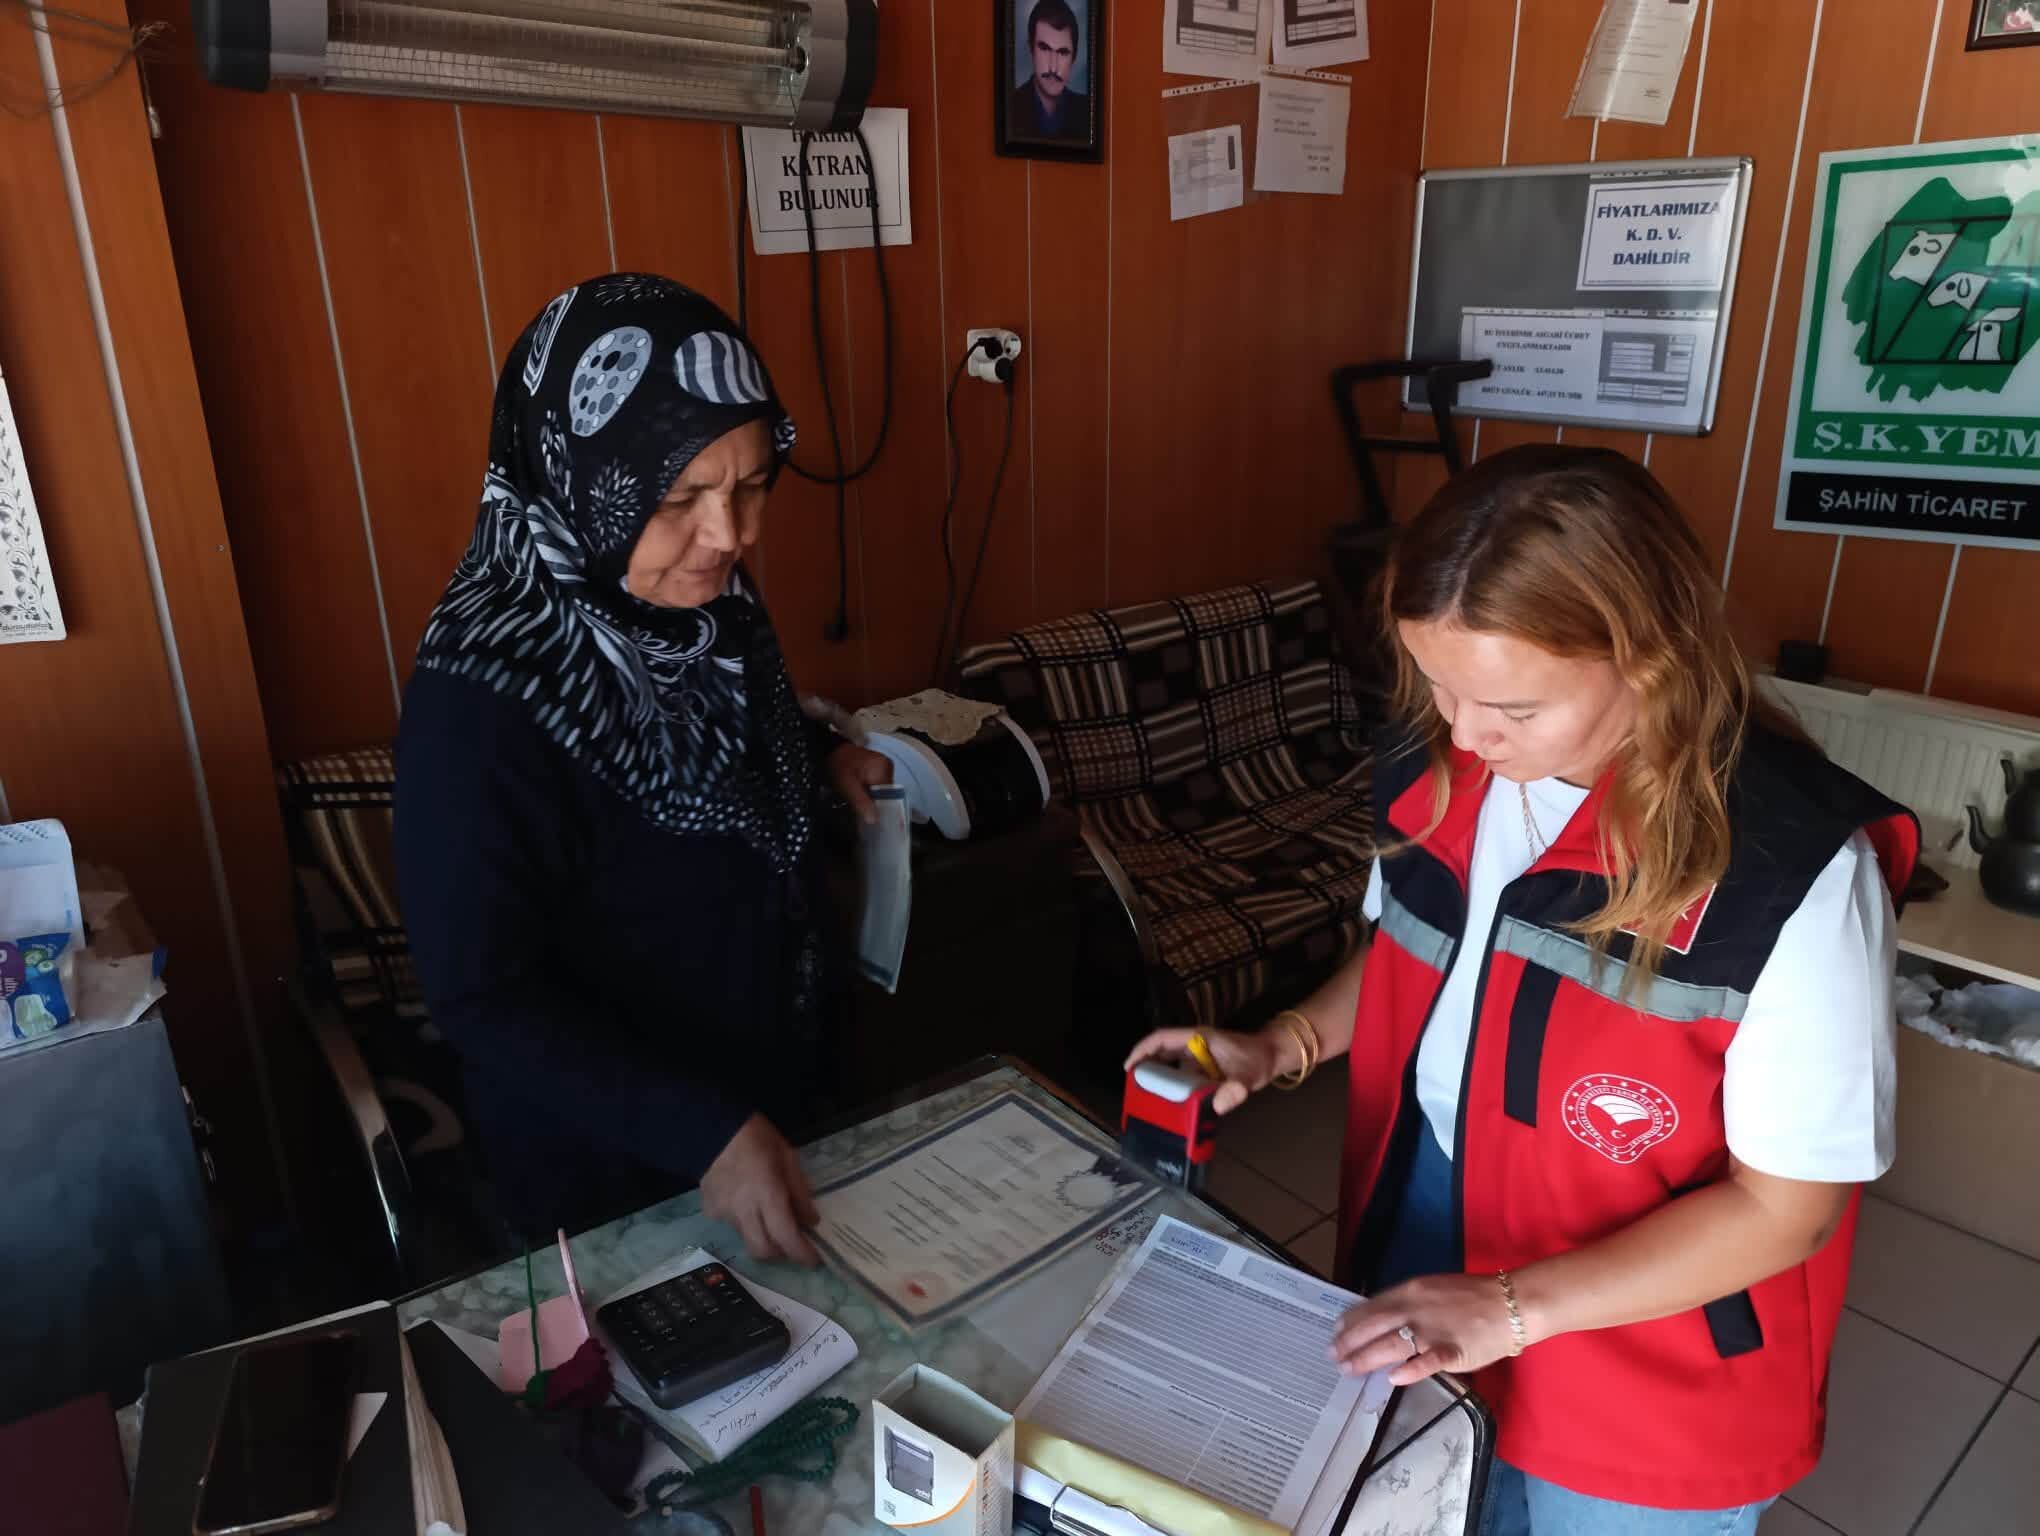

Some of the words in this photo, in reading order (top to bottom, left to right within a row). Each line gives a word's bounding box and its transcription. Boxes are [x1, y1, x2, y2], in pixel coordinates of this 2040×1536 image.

[1597, 202, 1719, 218] FİYATLARIMIZA
[1626, 229, 1642, 240] K.
[1667, 227, 1682, 240] V.
[1612, 249, 1691, 265] DAHİLDİR
[1819, 488, 1898, 512] ŞAHİN
[1906, 490, 2027, 521] TİCARET
